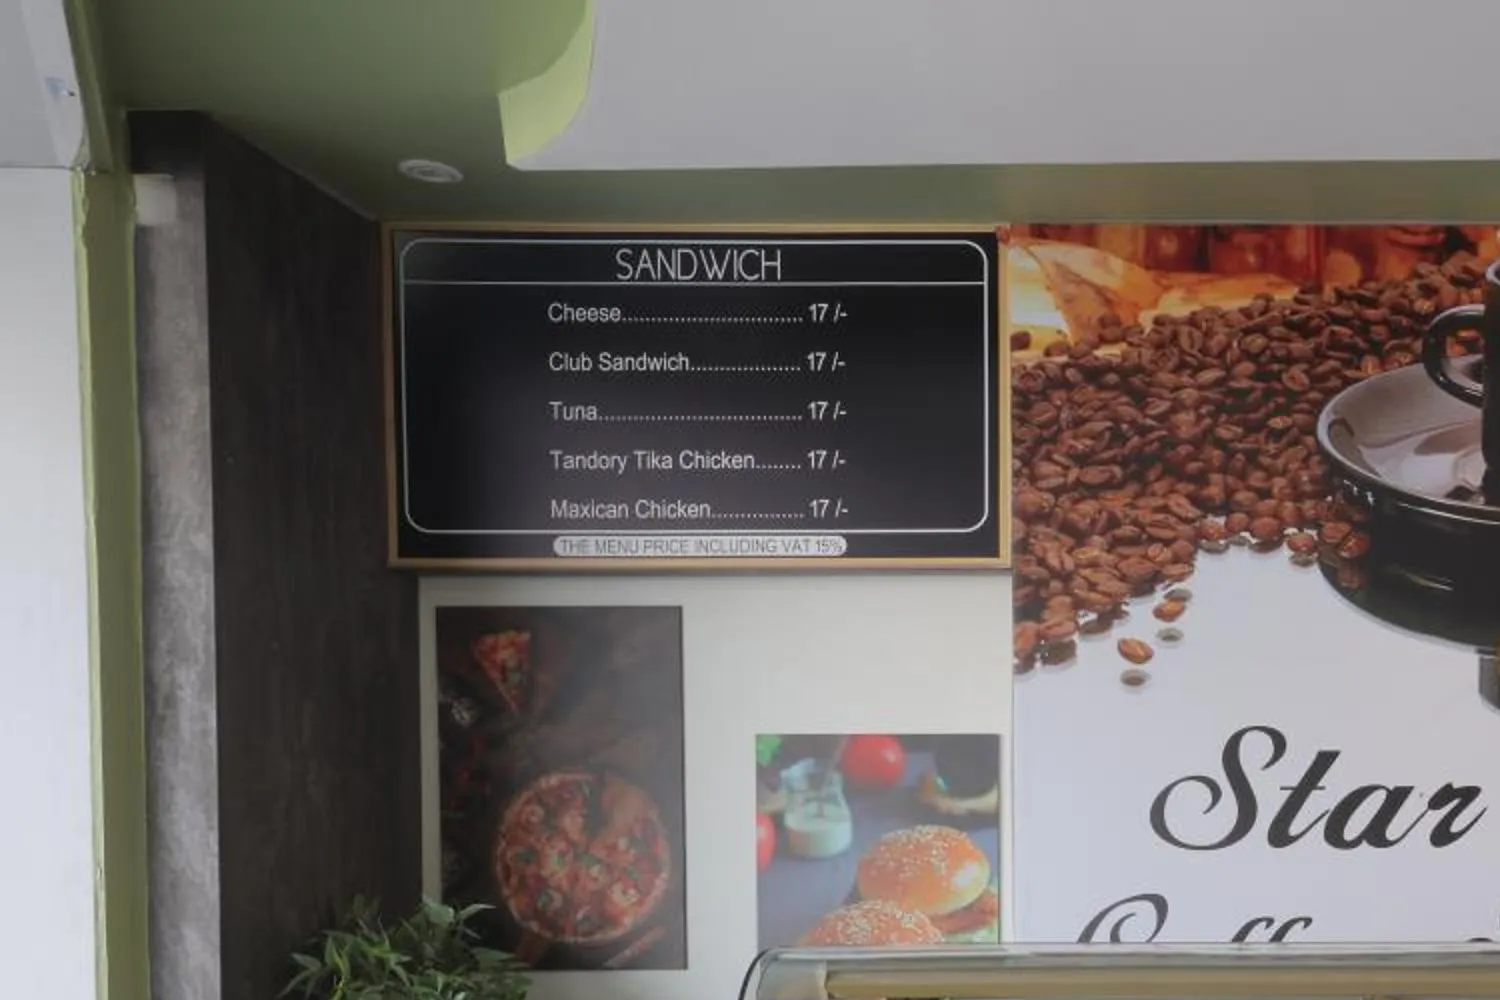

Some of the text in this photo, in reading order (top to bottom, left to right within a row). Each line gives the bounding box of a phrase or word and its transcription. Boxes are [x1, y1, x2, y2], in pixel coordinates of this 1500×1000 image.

[616, 248, 781, 280] SANDWICH
[548, 303, 621, 322] Cheese
[810, 304, 828, 321] 17
[549, 352, 592, 371] Club
[599, 352, 689, 371] Sandwich
[808, 352, 826, 371] 17
[549, 402, 597, 420] Tuna
[809, 401, 828, 420] 17
[550, 450, 627, 474] Tandory
[634, 451, 672, 469] Tika
[679, 450, 754, 469] Chicken
[808, 450, 826, 468] 17
[552, 499, 628, 518] Maxican
[635, 500, 710, 518] Chicken
[810, 499, 829, 517] 17
[560, 540, 591, 553] THE
[643, 540, 690, 553] PRICE
[781, 540, 810, 553] VAT
[815, 540, 842, 553] 15%
[1150, 726, 1487, 850] Star
